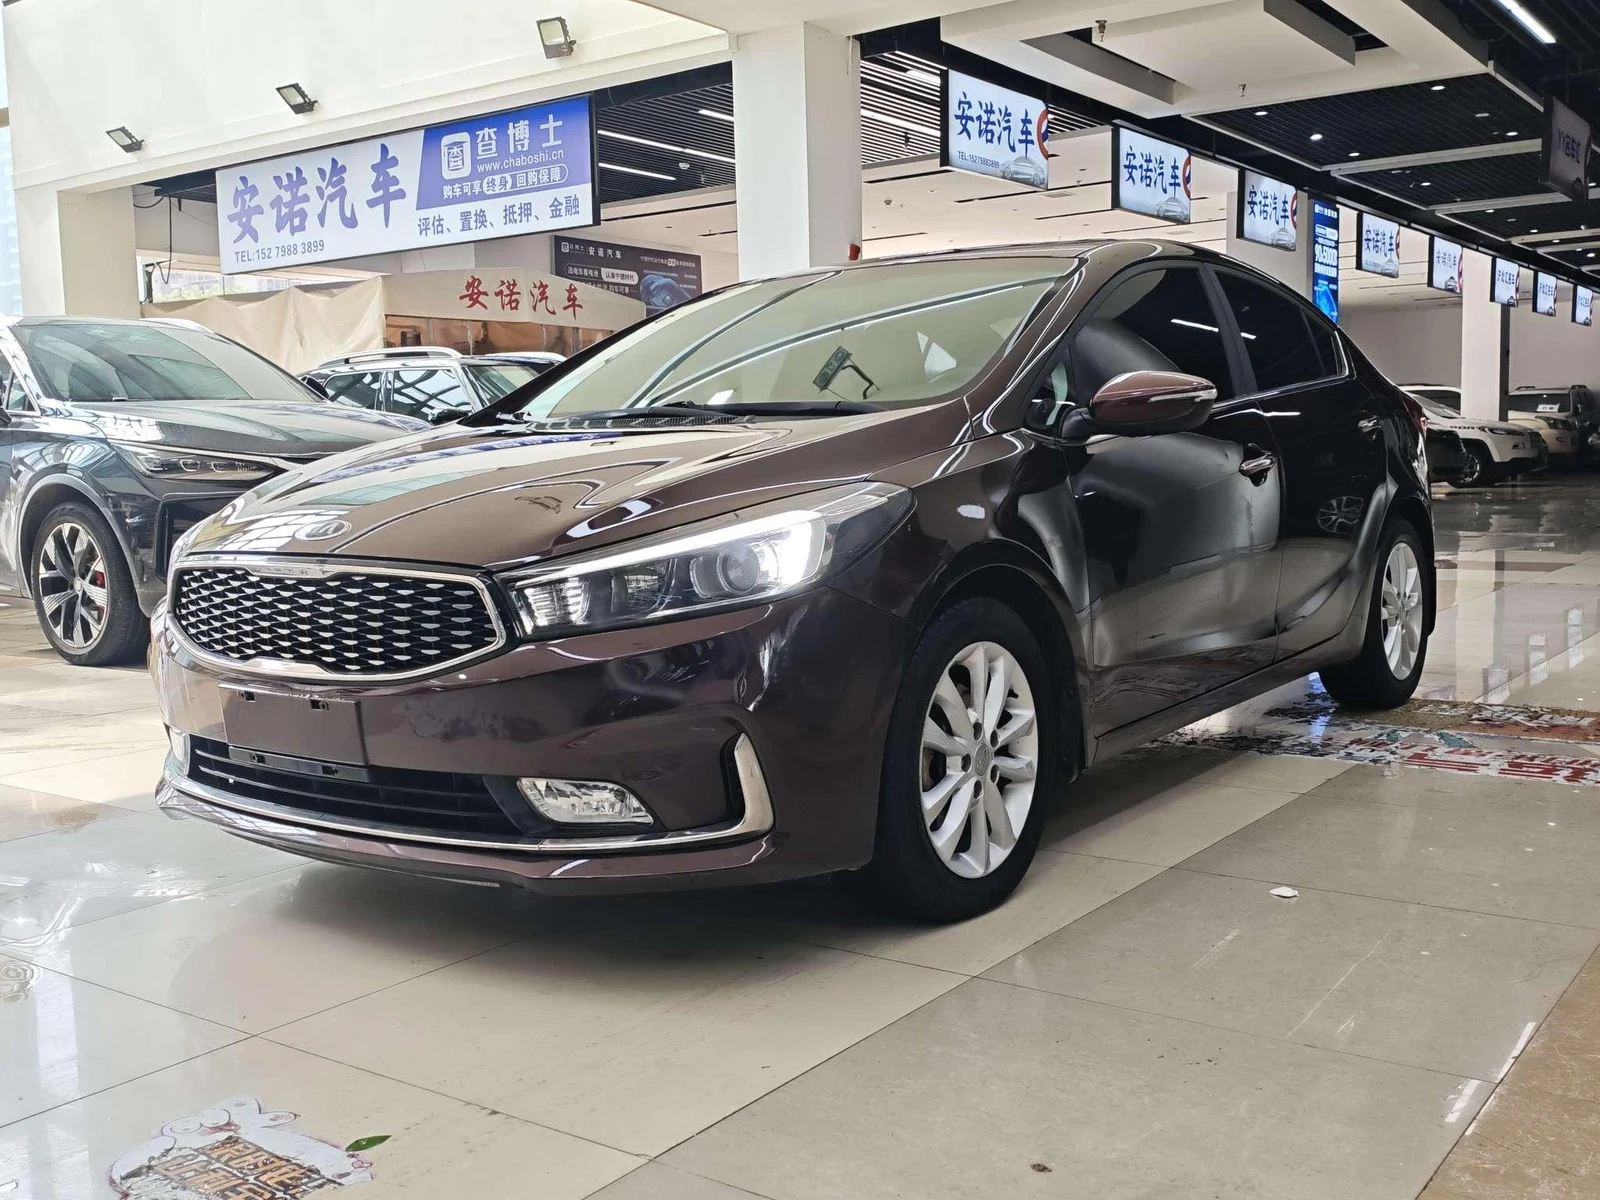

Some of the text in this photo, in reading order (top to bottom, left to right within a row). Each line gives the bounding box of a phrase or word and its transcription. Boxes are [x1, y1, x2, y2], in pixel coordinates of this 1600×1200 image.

[476, 114, 564, 160] 查博士
[954, 91, 1035, 158] 安诺汽车
[477, 149, 564, 173] www.chaboshi.cn
[1123, 146, 1181, 198] 安诺汽车
[227, 142, 407, 244] 安诺汽车
[1247, 185, 1290, 229] 安诺汽车
[234, 240, 325, 264] TEL:152 7988 3899
[588, 246, 622, 260] 安诺汽车
[1364, 225, 1395, 259] 安诺汽车
[459, 275, 584, 320] 安诺汽车
